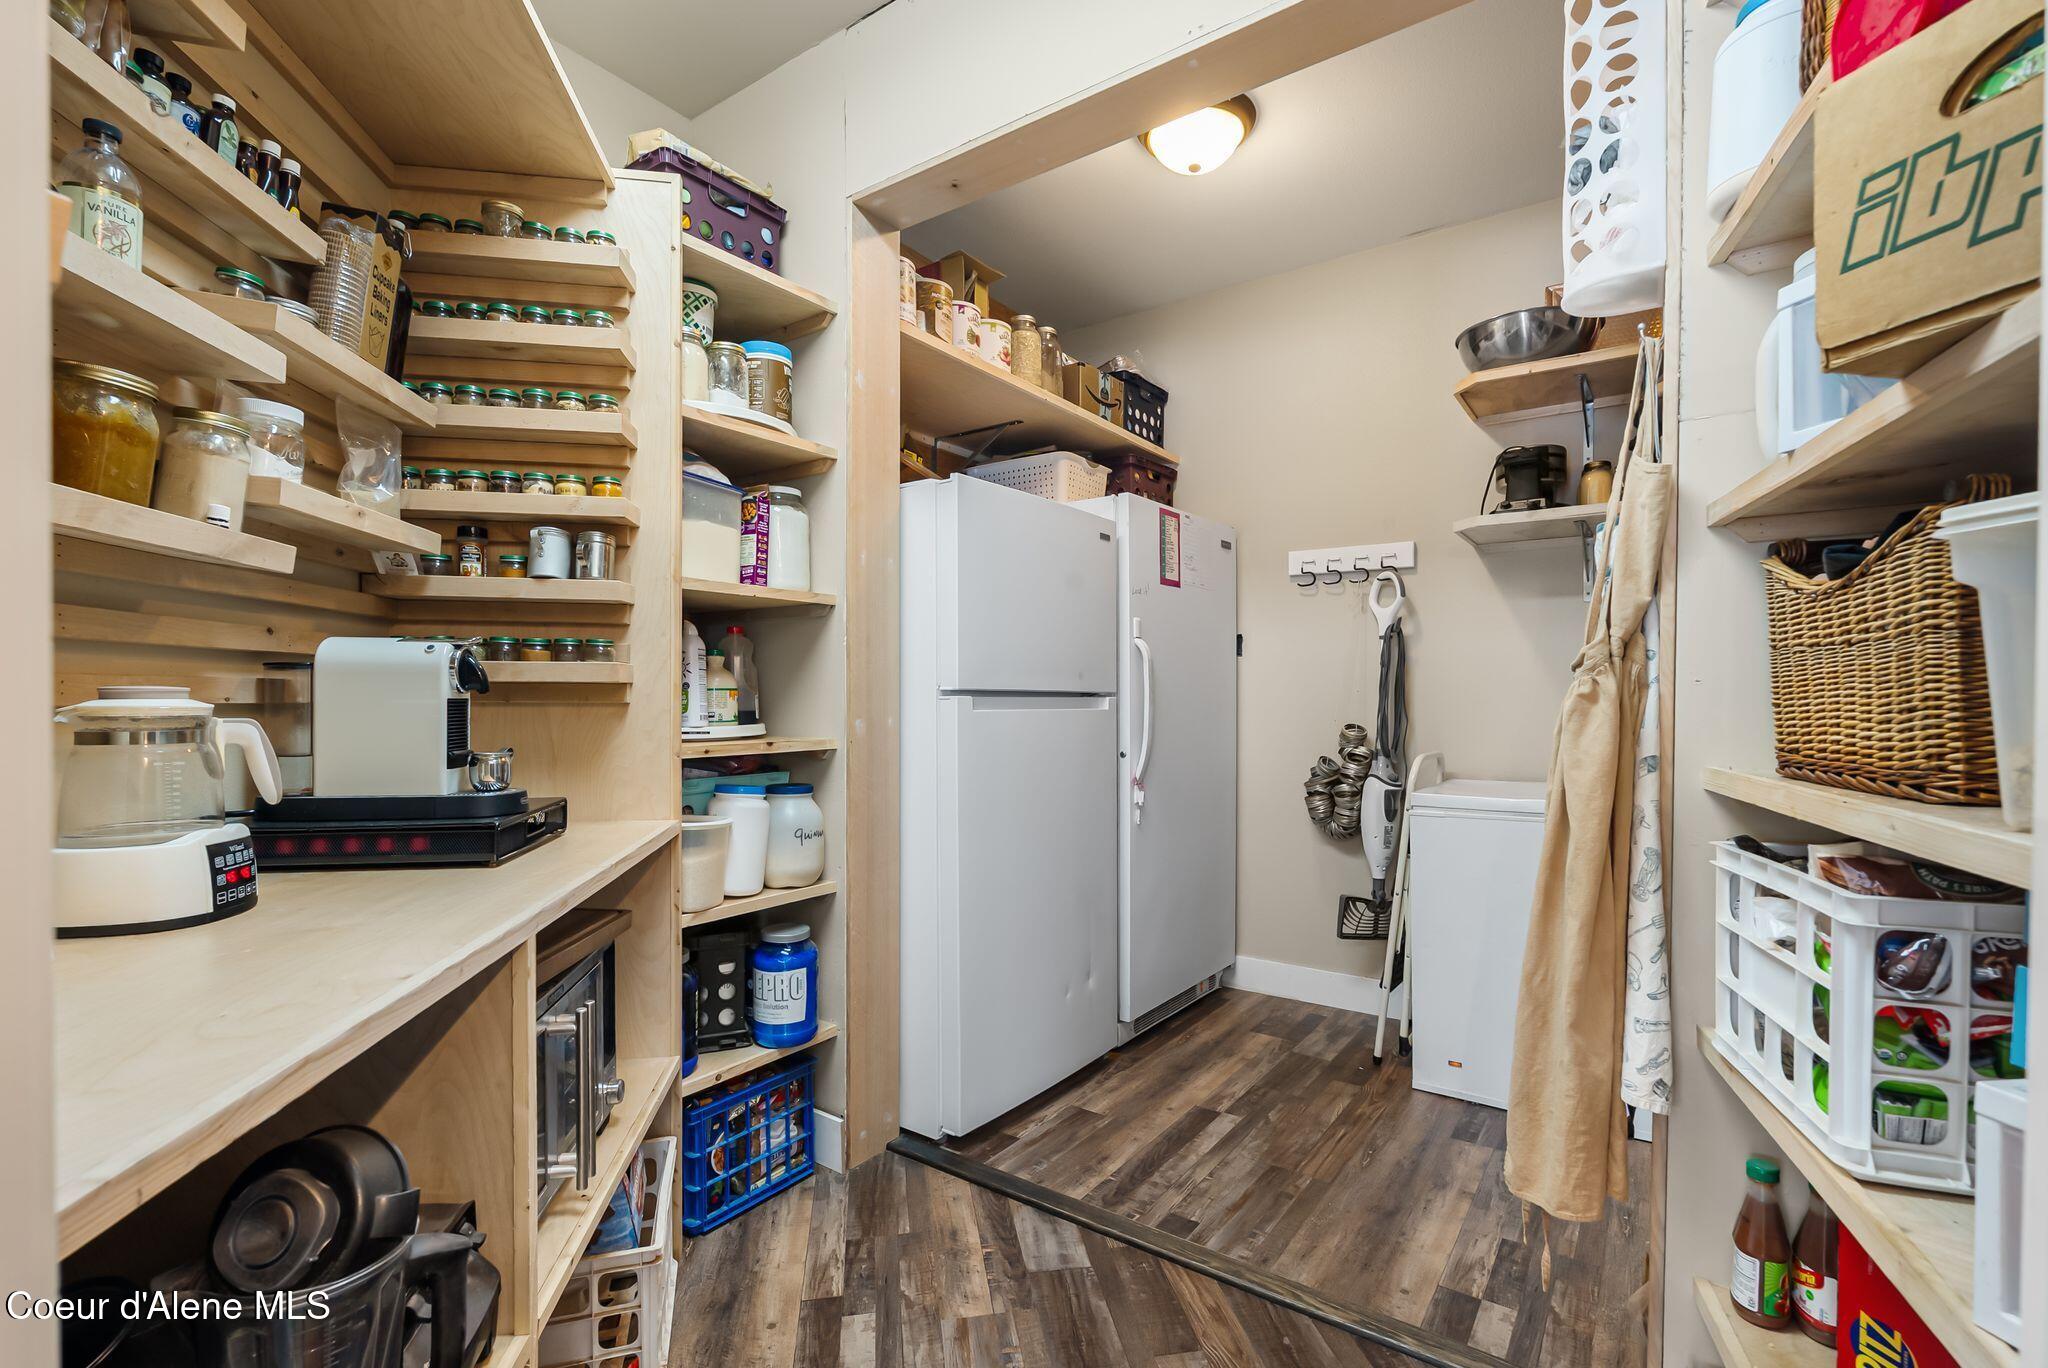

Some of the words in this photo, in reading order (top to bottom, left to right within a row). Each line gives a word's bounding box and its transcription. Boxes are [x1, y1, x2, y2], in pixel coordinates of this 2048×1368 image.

[87, 201, 136, 227] VANILLA
[372, 265, 396, 294] Cupcake
[372, 285, 391, 313] Baking
[370, 302, 388, 327] Liners
